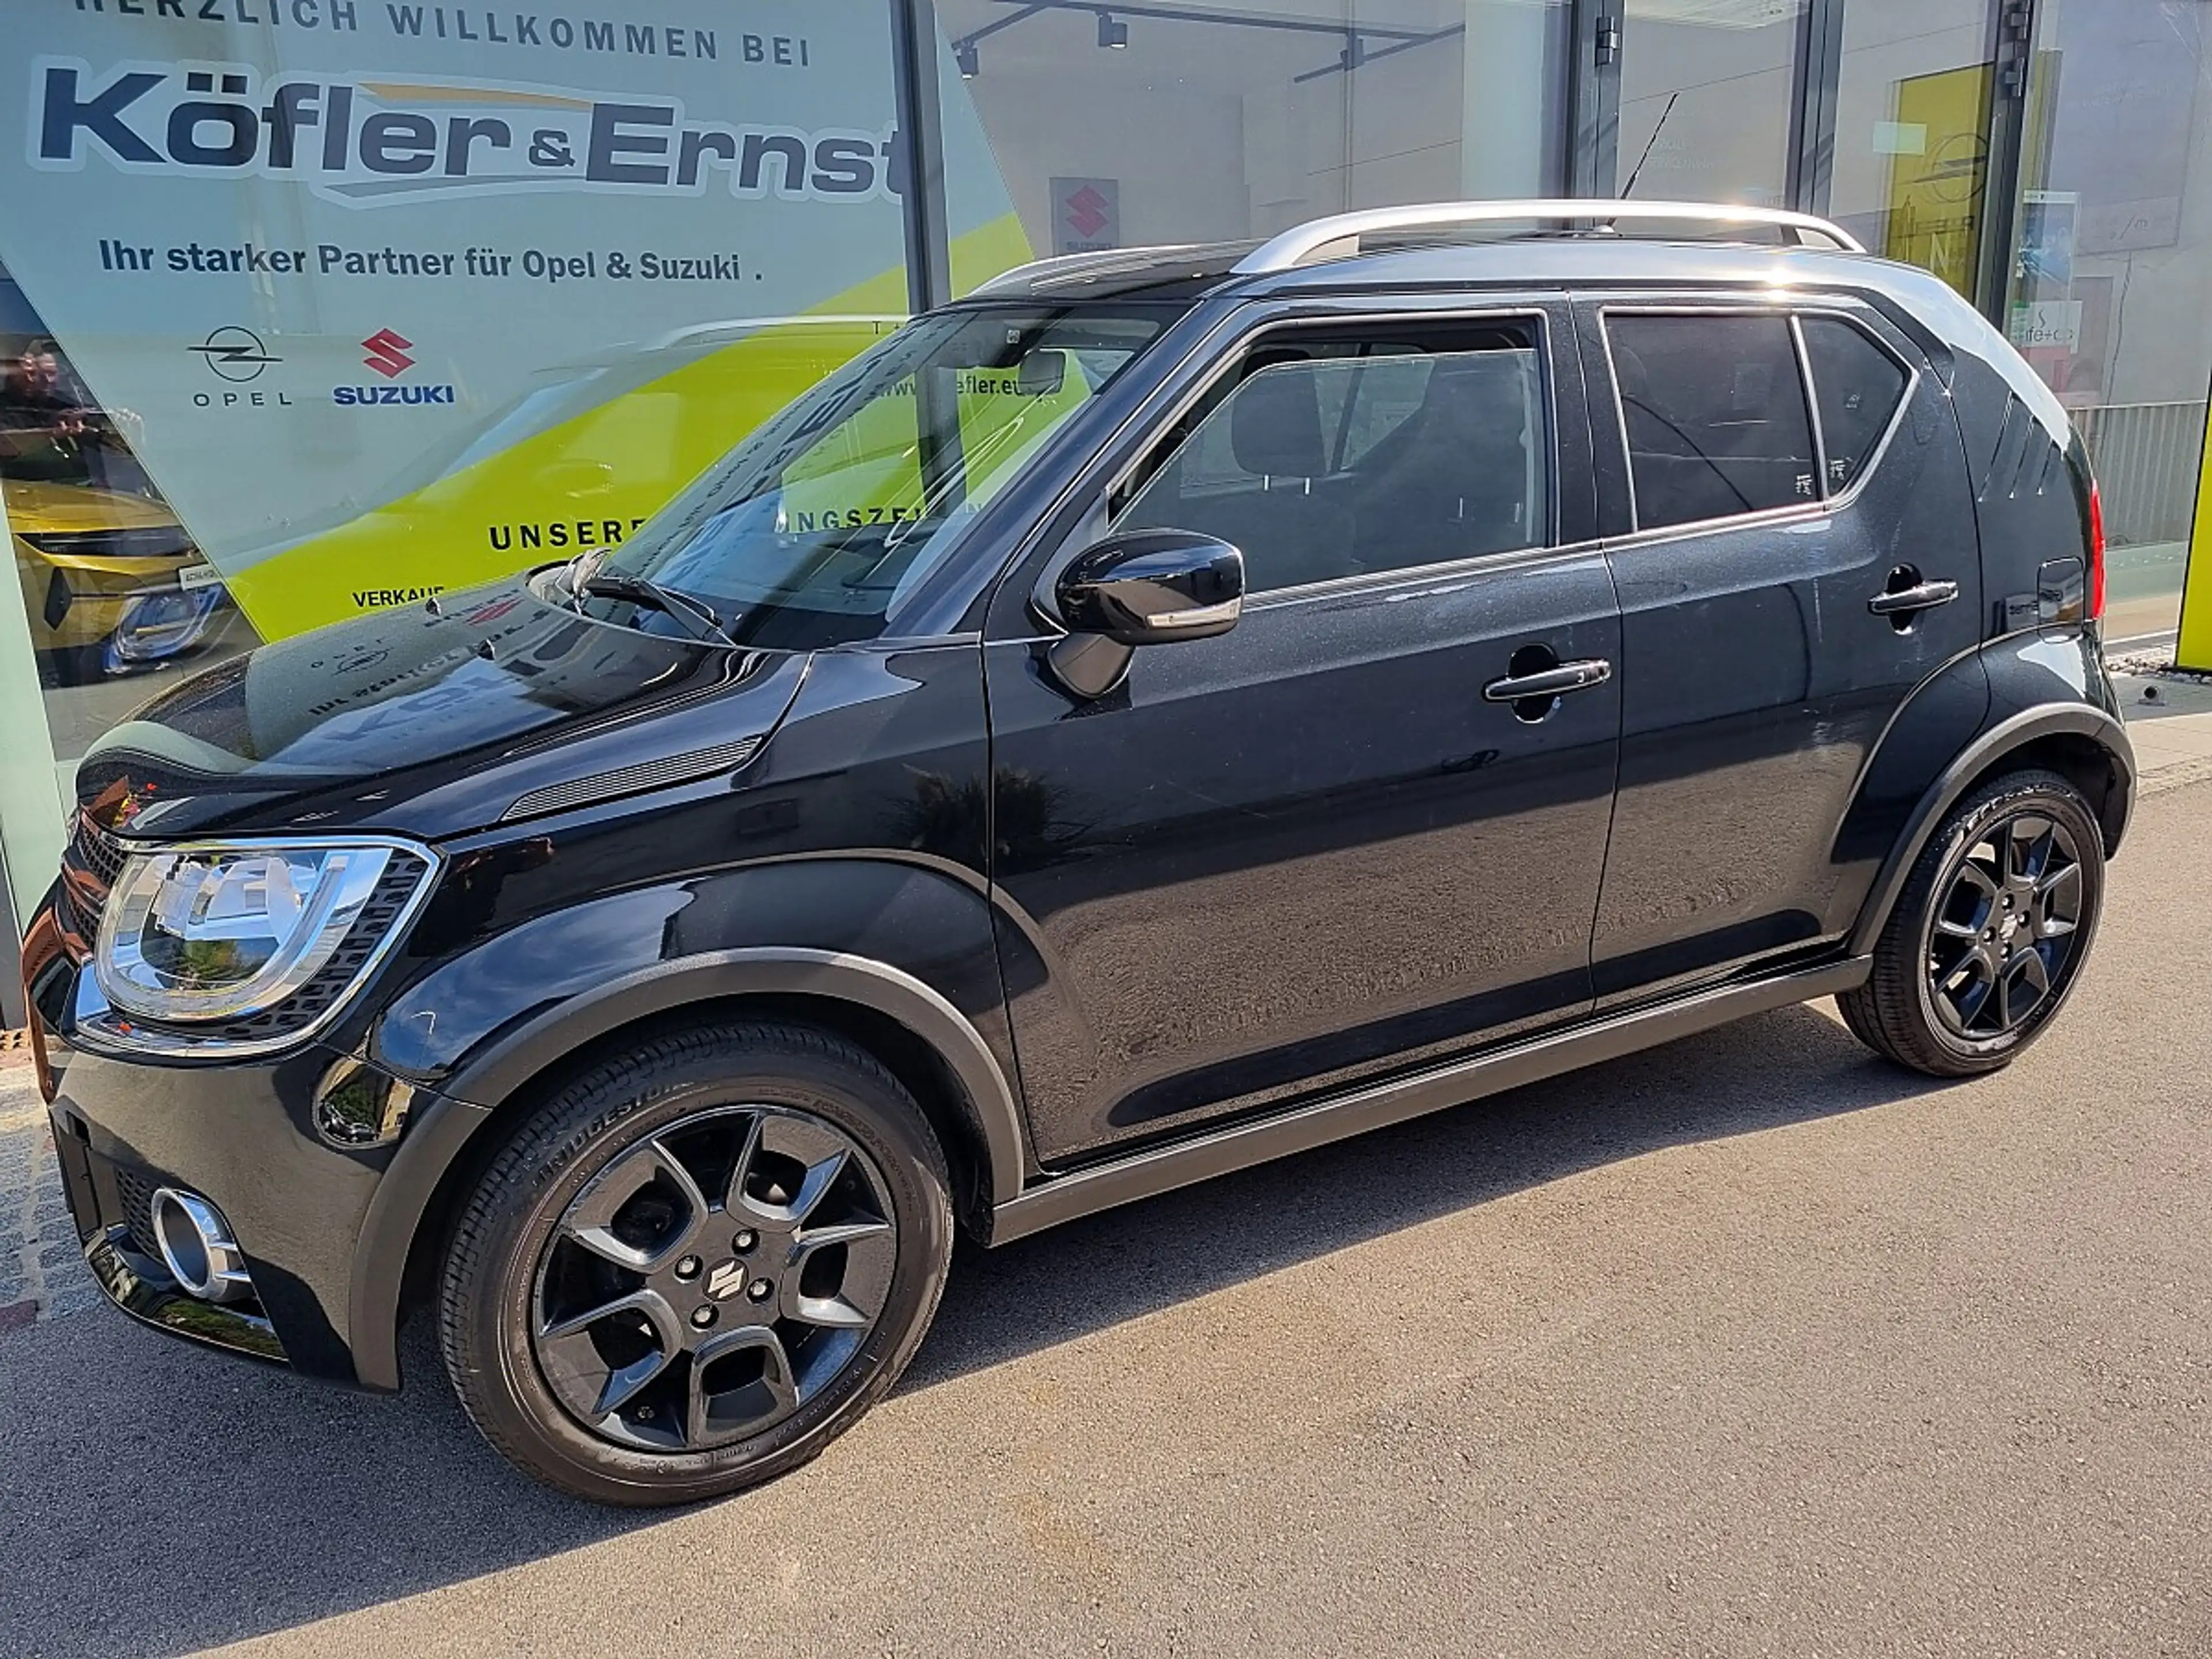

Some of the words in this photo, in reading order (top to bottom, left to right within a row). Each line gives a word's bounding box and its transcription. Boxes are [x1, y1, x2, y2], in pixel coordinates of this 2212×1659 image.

[387, 3, 717, 60] WILLKOMMEN
[743, 35, 809, 67] BEI
[40, 68, 512, 176] Köfler
[529, 129, 576, 168] &
[100, 240, 154, 271] Ihr
[168, 243, 306, 273] starker
[319, 245, 454, 276] Partner
[465, 247, 512, 277] für
[522, 250, 596, 283] Opel
[606, 252, 632, 279] &
[640, 253, 740, 281] Suzuki
[193, 392, 292, 407] OPEL
[334, 385, 454, 406] SUZUKI
